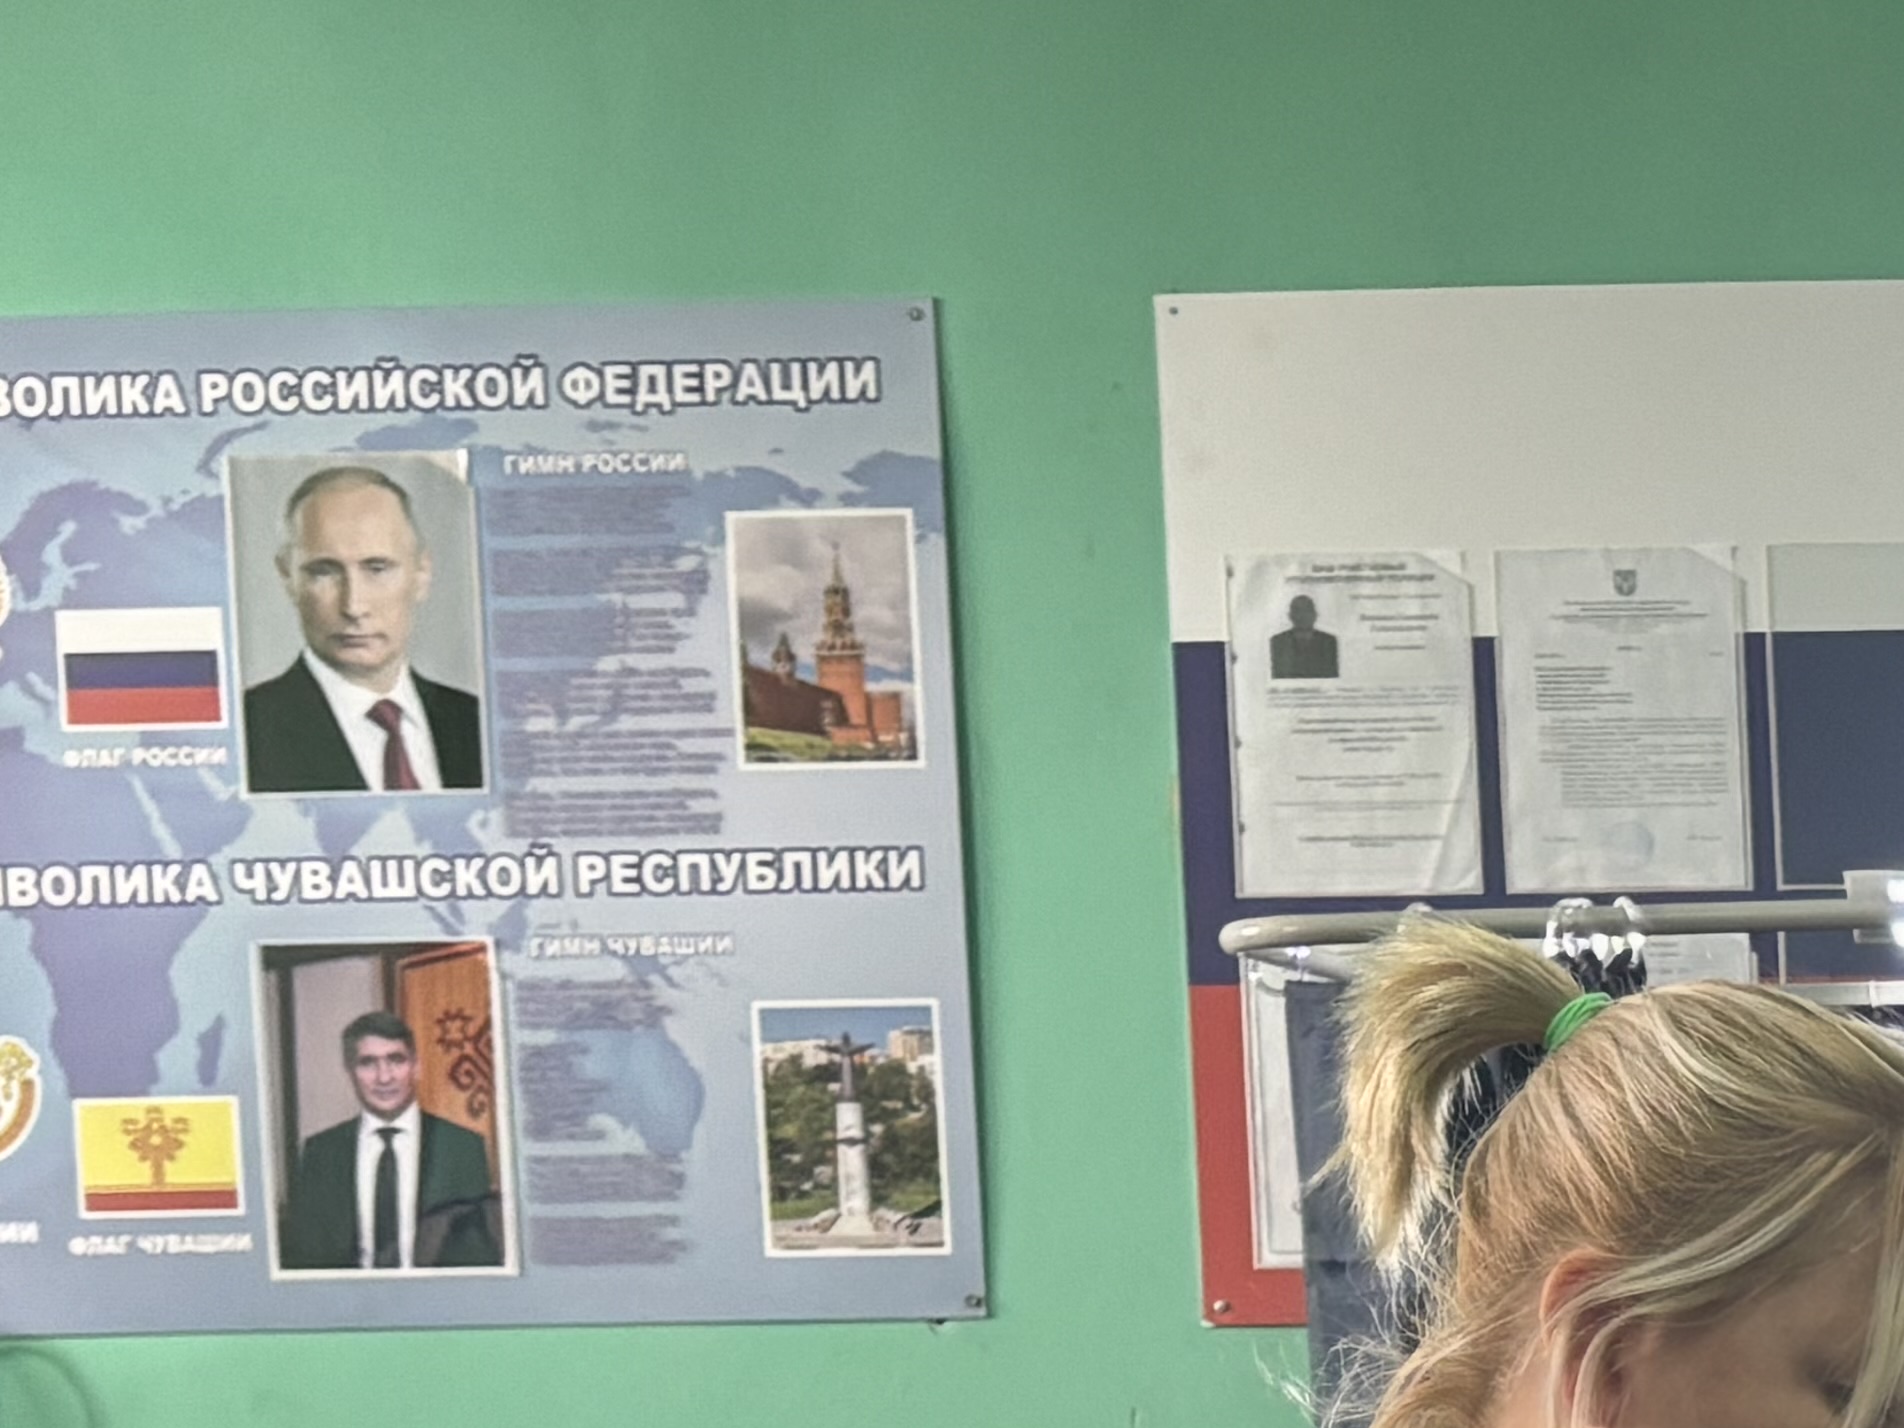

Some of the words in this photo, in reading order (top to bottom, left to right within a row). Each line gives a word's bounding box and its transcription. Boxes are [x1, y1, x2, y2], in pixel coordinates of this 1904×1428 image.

[199, 355, 546, 415] РОССИЙСКОЙ
[561, 358, 880, 412] ФЕДЕРАЦИИ
[503, 455, 576, 476] ГИМН
[582, 452, 688, 475] РОССИИ
[132, 747, 228, 767] РОССИИ
[0, 863, 219, 908] ВОЛИКА
[233, 847, 560, 902] ЧУВАШСКОЙ
[577, 848, 923, 896] РЕСПУБЛИКИ
